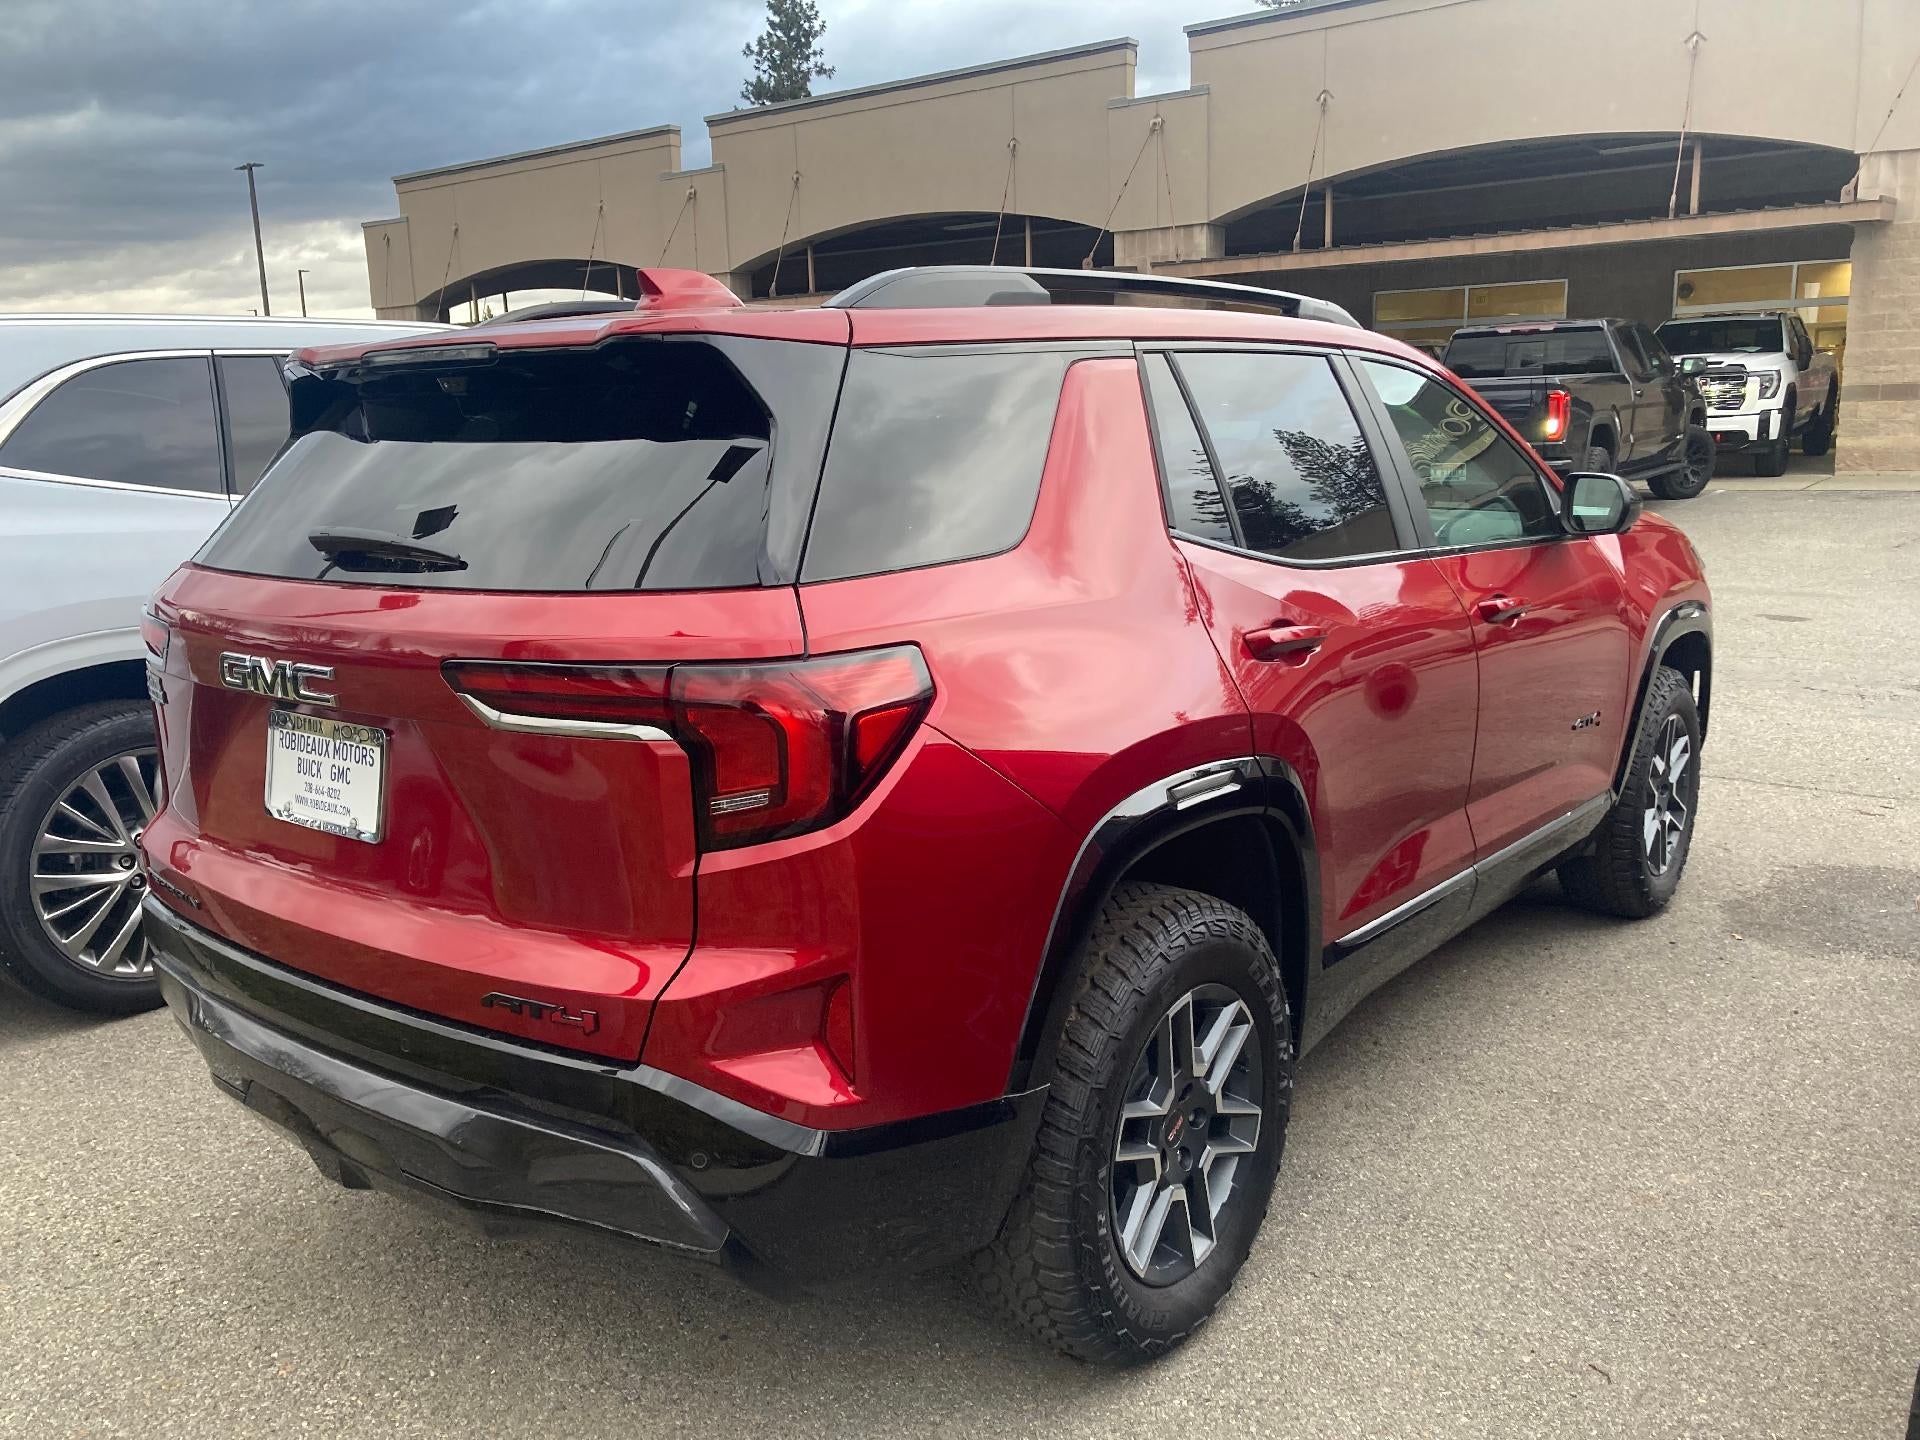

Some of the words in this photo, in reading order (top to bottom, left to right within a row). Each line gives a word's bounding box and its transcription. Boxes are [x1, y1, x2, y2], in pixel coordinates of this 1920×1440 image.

[220, 651, 337, 707] GMC
[279, 730, 331, 758] ROBIDEAUX
[333, 742, 375, 767] MOTORS
[297, 757, 322, 779] BUICK
[330, 765, 351, 785] GMC
[481, 992, 599, 1036] AT4
